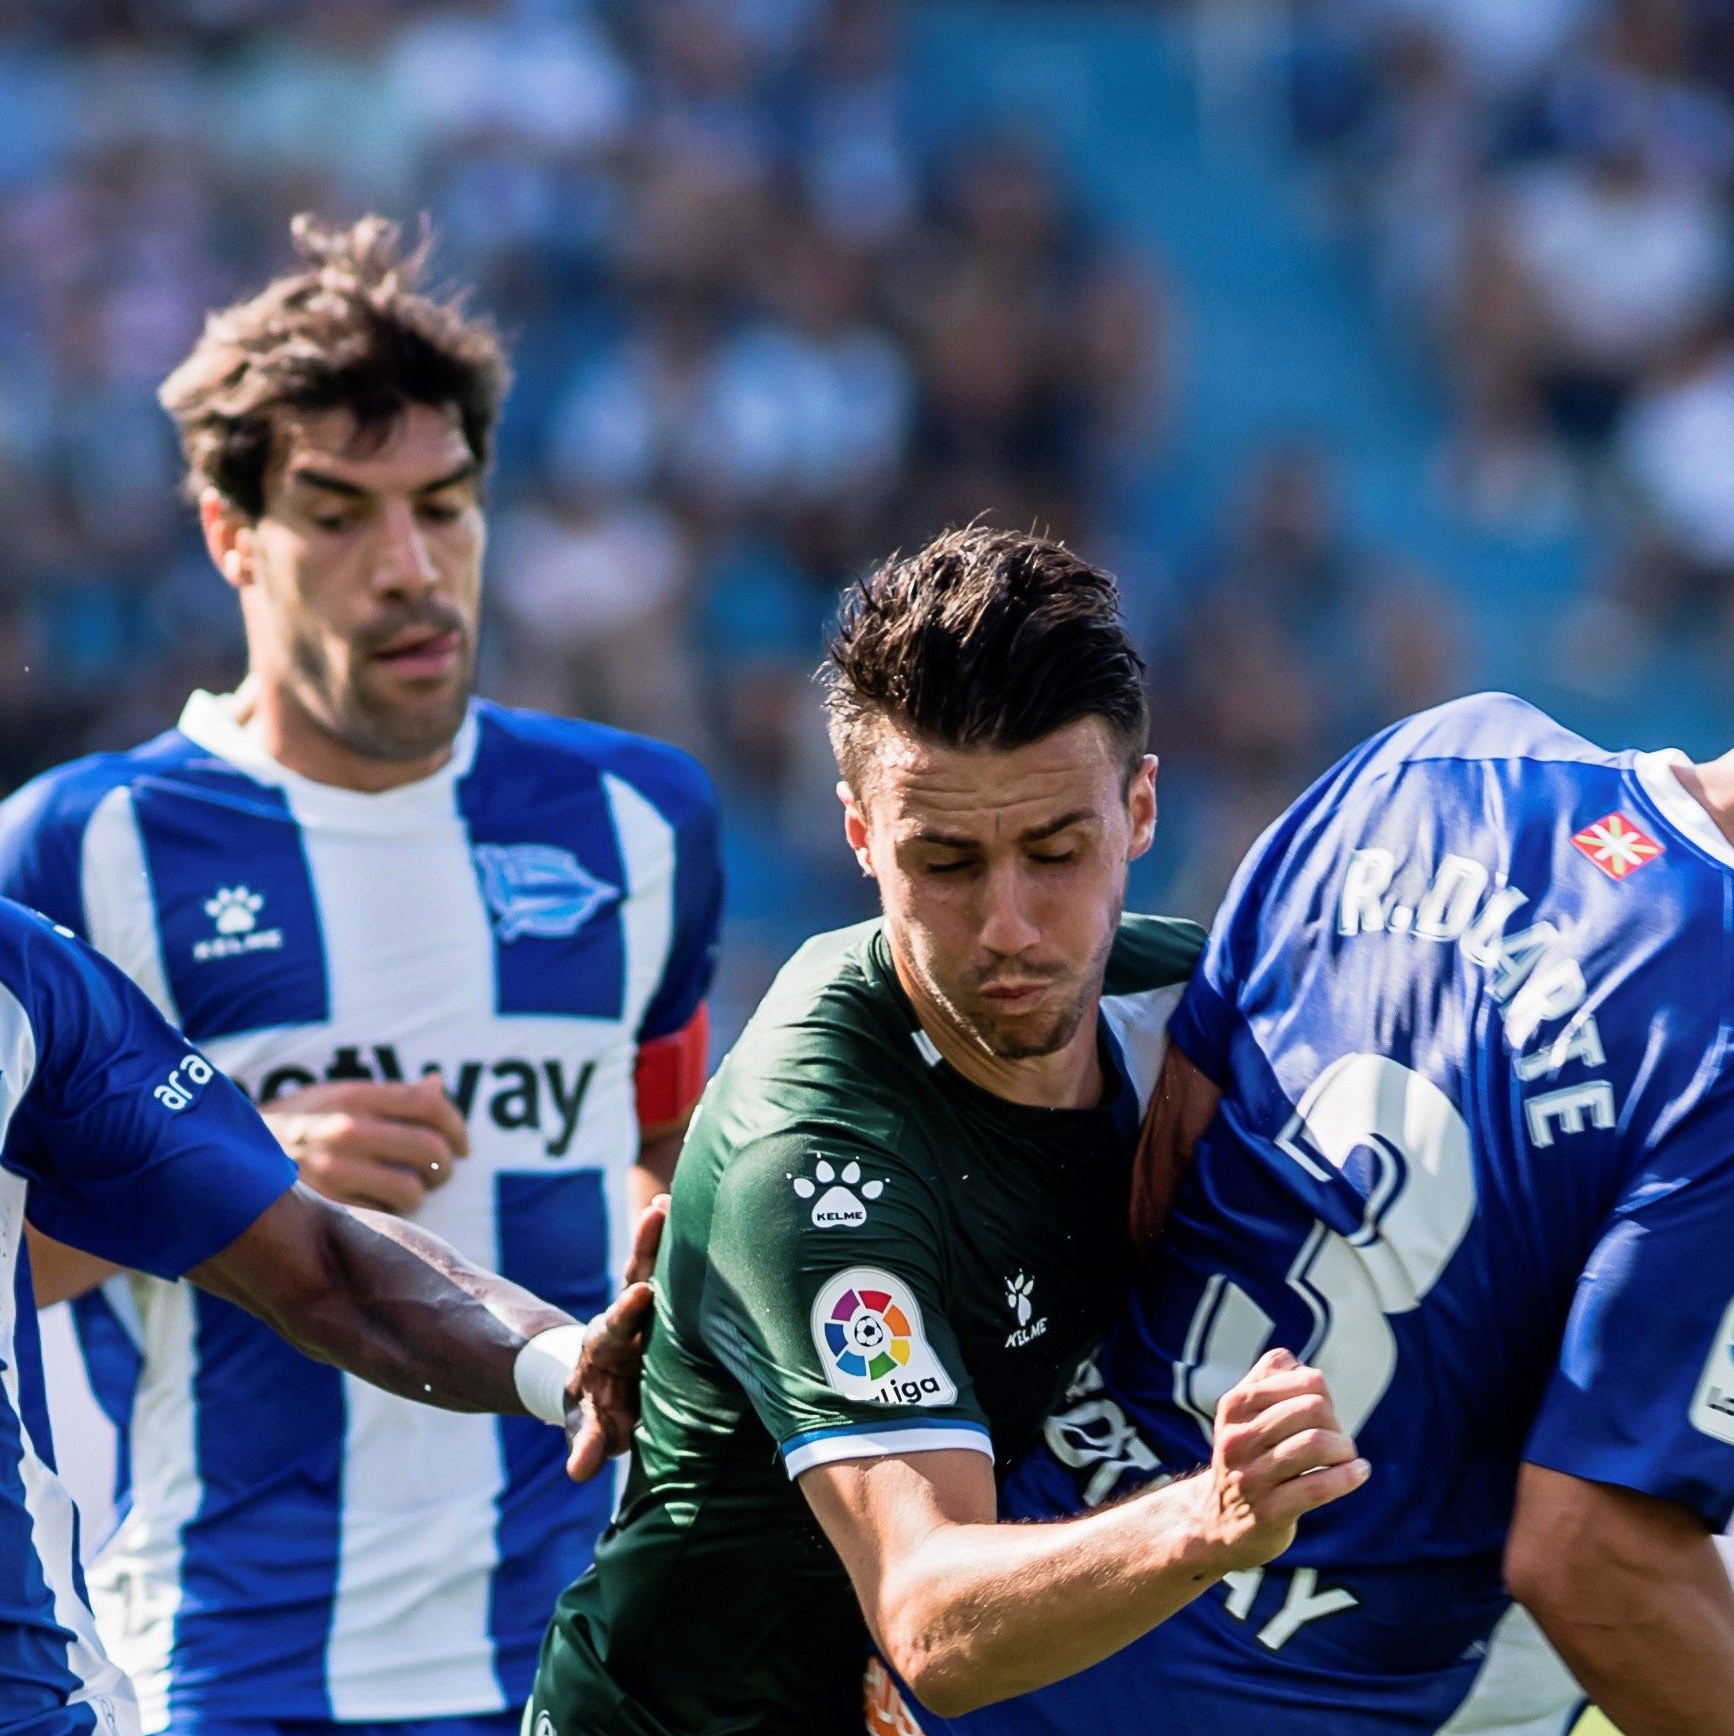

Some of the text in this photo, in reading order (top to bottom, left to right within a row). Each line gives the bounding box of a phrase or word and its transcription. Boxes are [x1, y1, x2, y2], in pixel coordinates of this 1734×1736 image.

[153, 1045, 215, 1111] ara
[816, 1211, 863, 1222] KELME
[1004, 1316, 1048, 1348] KELME
